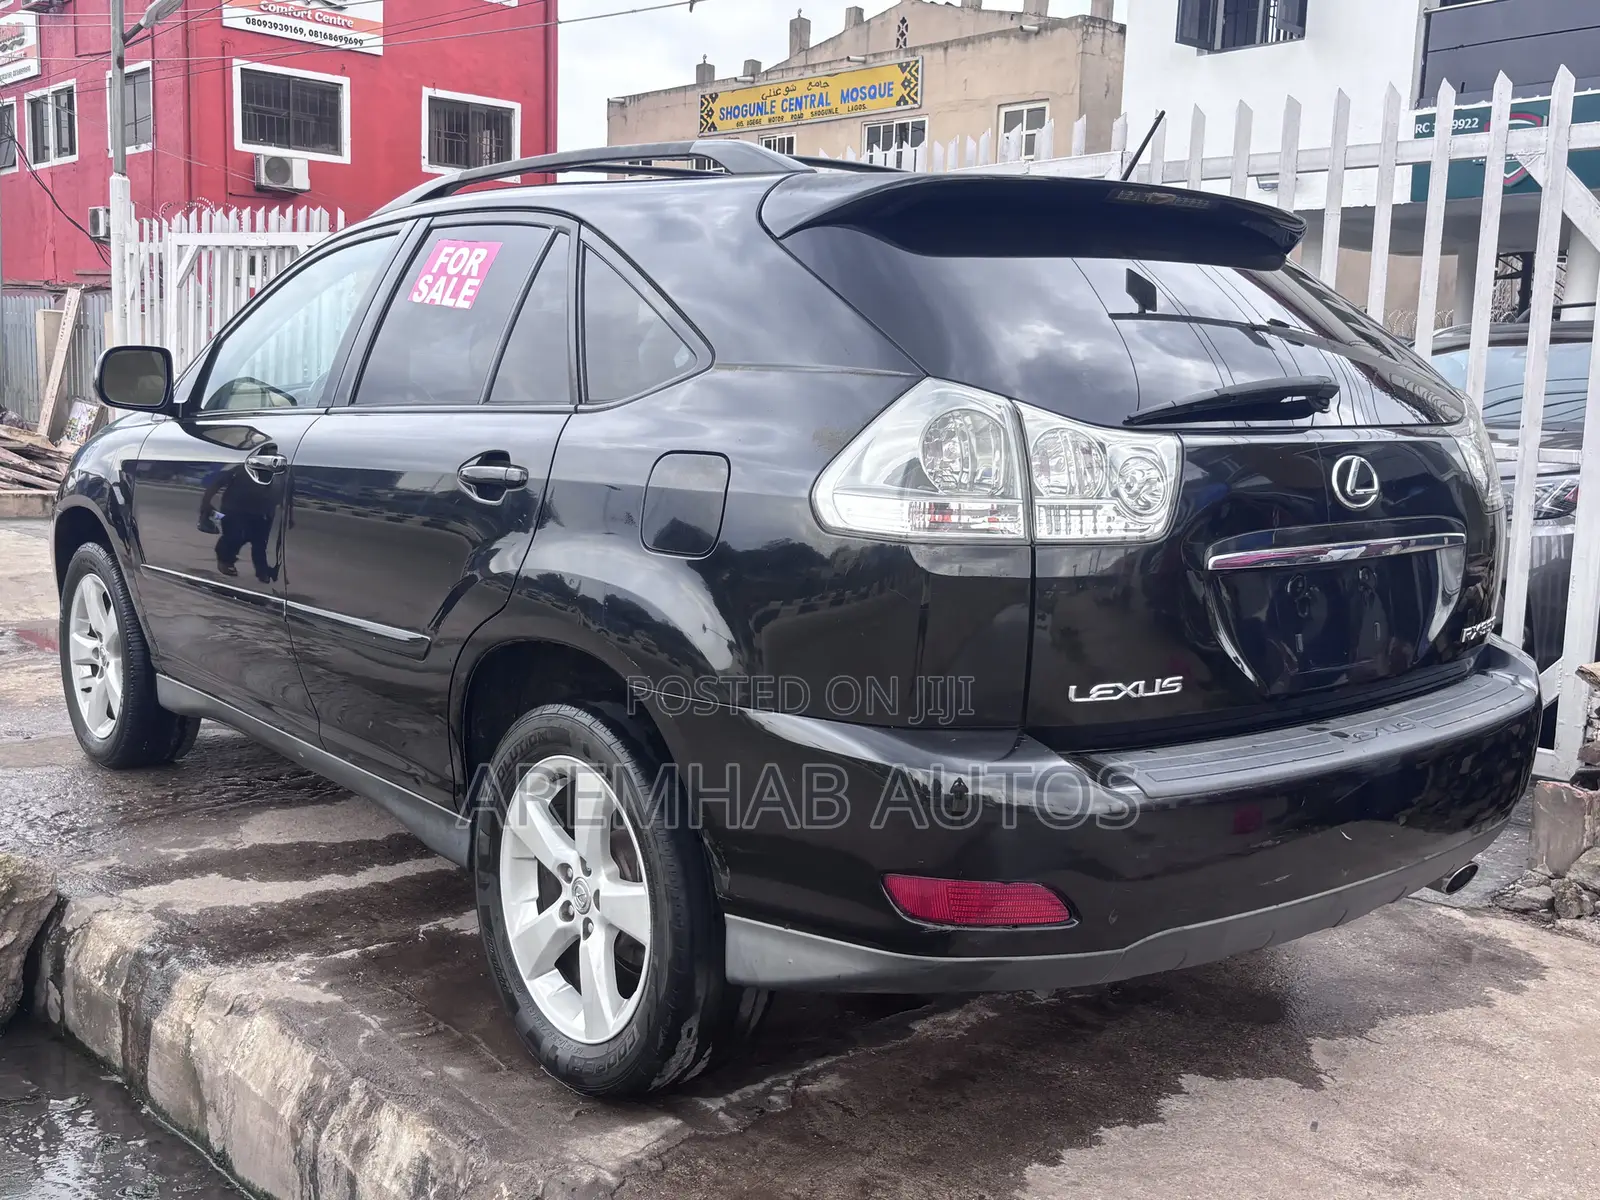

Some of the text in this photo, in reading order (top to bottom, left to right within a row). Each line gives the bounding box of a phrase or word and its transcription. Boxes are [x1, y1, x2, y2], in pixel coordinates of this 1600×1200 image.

[245, 17, 307, 37] 08093939169,
[259, 1, 354, 28] Comfort Centre
[719, 81, 894, 121] SHOGUNLE CENTRAL MOSQUE
[791, 112, 804, 121] ROAD
[1415, 117, 1479, 134] RC 9922
[431, 246, 488, 277] FOR
[412, 274, 481, 309] SALE
[1068, 676, 1183, 702] LEXUS
